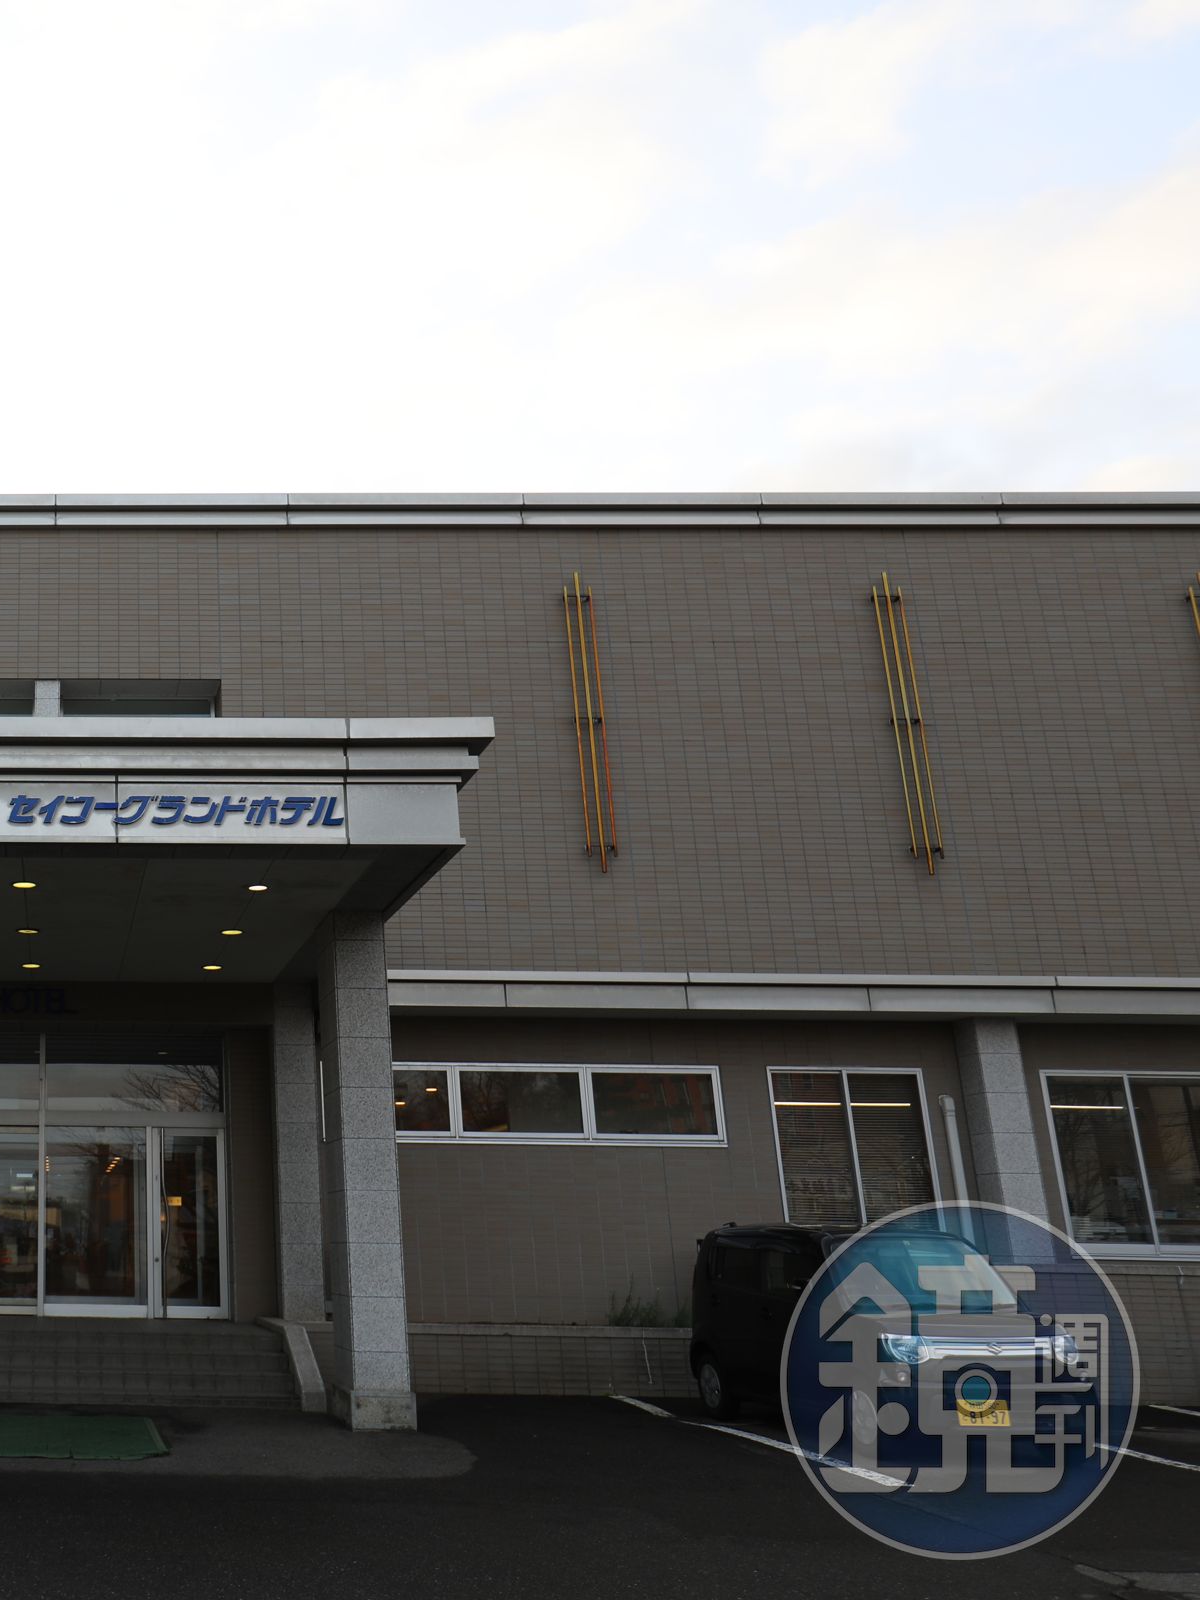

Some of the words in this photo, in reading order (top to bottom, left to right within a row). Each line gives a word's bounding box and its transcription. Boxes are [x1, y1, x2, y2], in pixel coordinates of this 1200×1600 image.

[7, 794, 344, 826] セイコーグランドホテル
